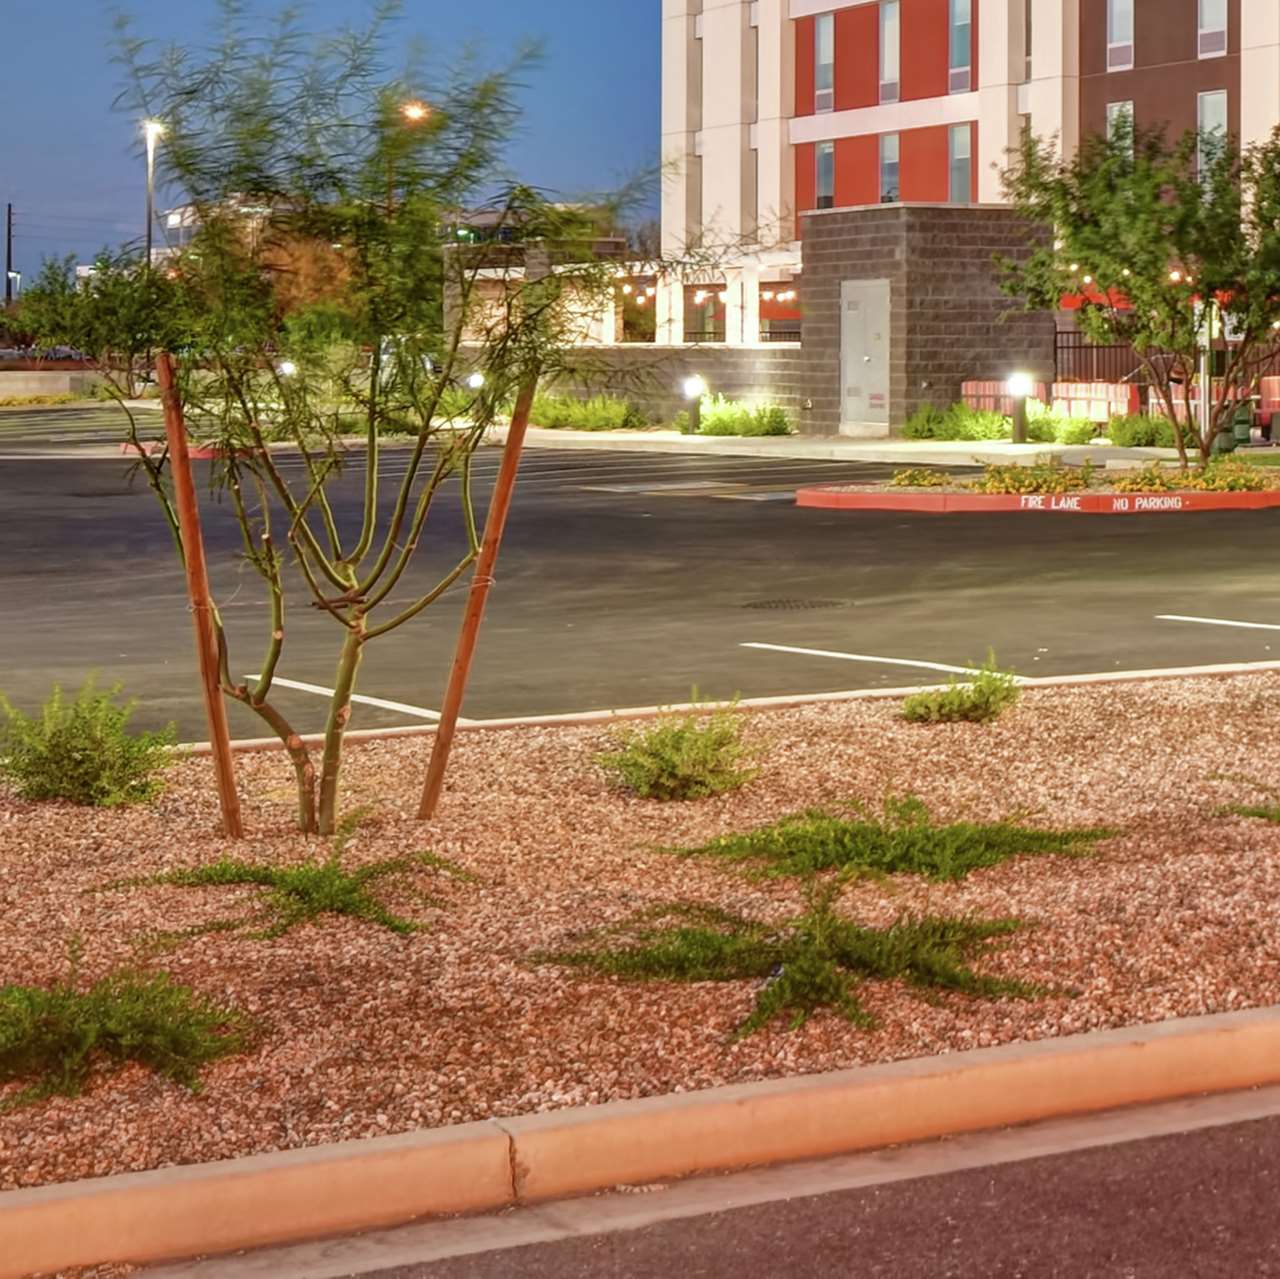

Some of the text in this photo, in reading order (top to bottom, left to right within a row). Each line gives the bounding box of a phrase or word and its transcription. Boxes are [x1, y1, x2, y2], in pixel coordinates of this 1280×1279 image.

[1020, 495, 1182, 511] FIRE LANE NO PARKING
